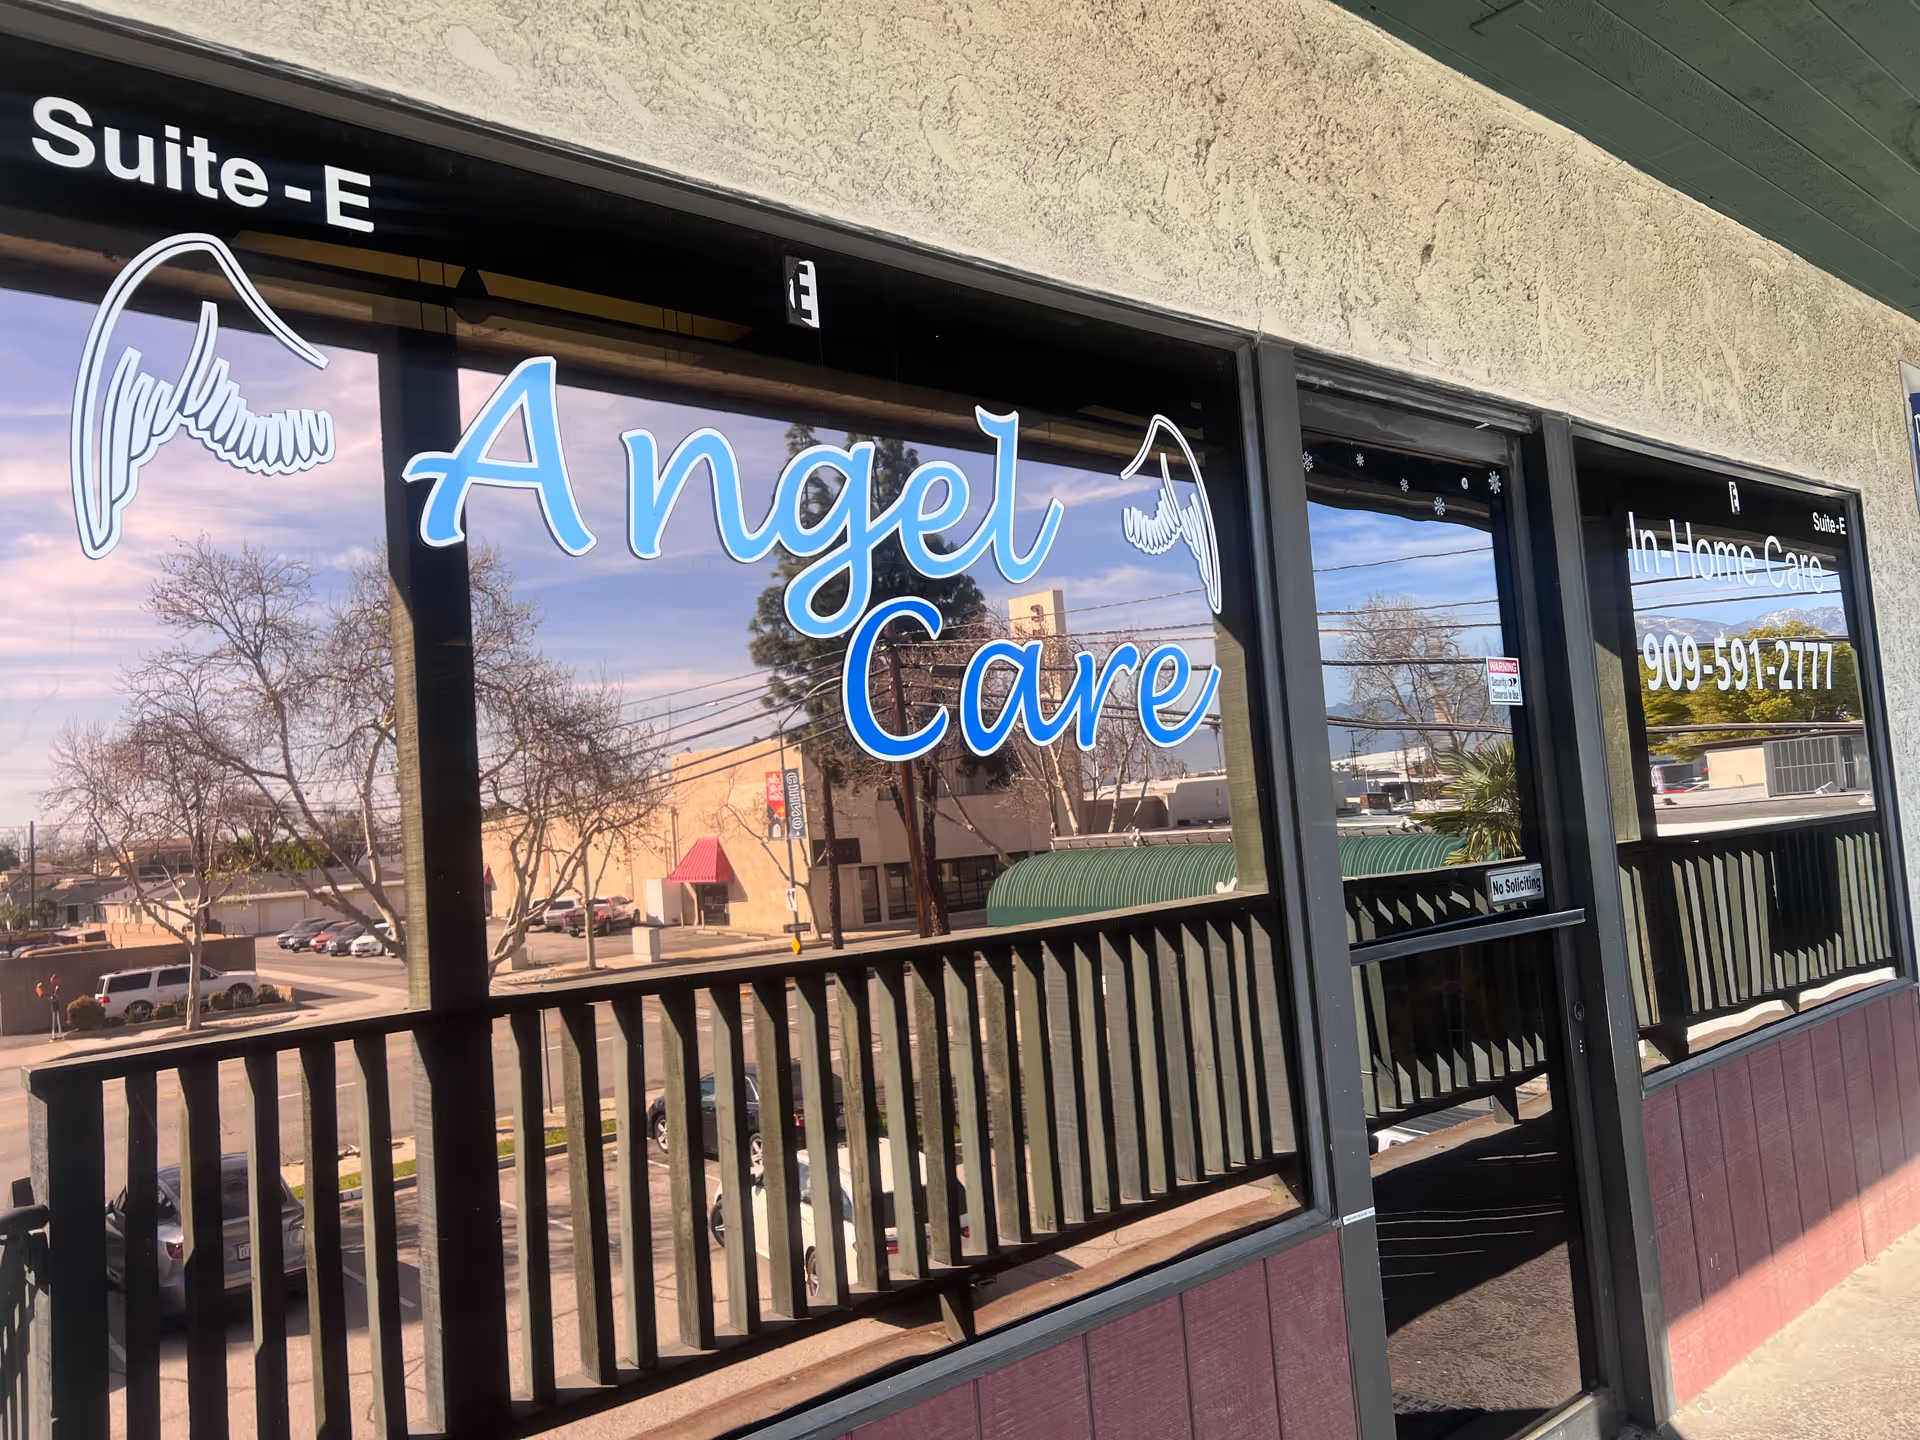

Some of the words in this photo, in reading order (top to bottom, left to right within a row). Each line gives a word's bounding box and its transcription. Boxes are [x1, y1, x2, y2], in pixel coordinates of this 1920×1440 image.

[791, 263, 813, 321] E
[402, 355, 1065, 638] Angel
[1628, 511, 1756, 586] In-Home
[1764, 535, 1824, 593] Care
[842, 597, 1221, 761] Care
[1489, 662, 1517, 673] WARNING
[1642, 633, 1832, 691] 909-591-2777
[1493, 881, 1504, 895] No
[1505, 875, 1541, 893] Soliciting
